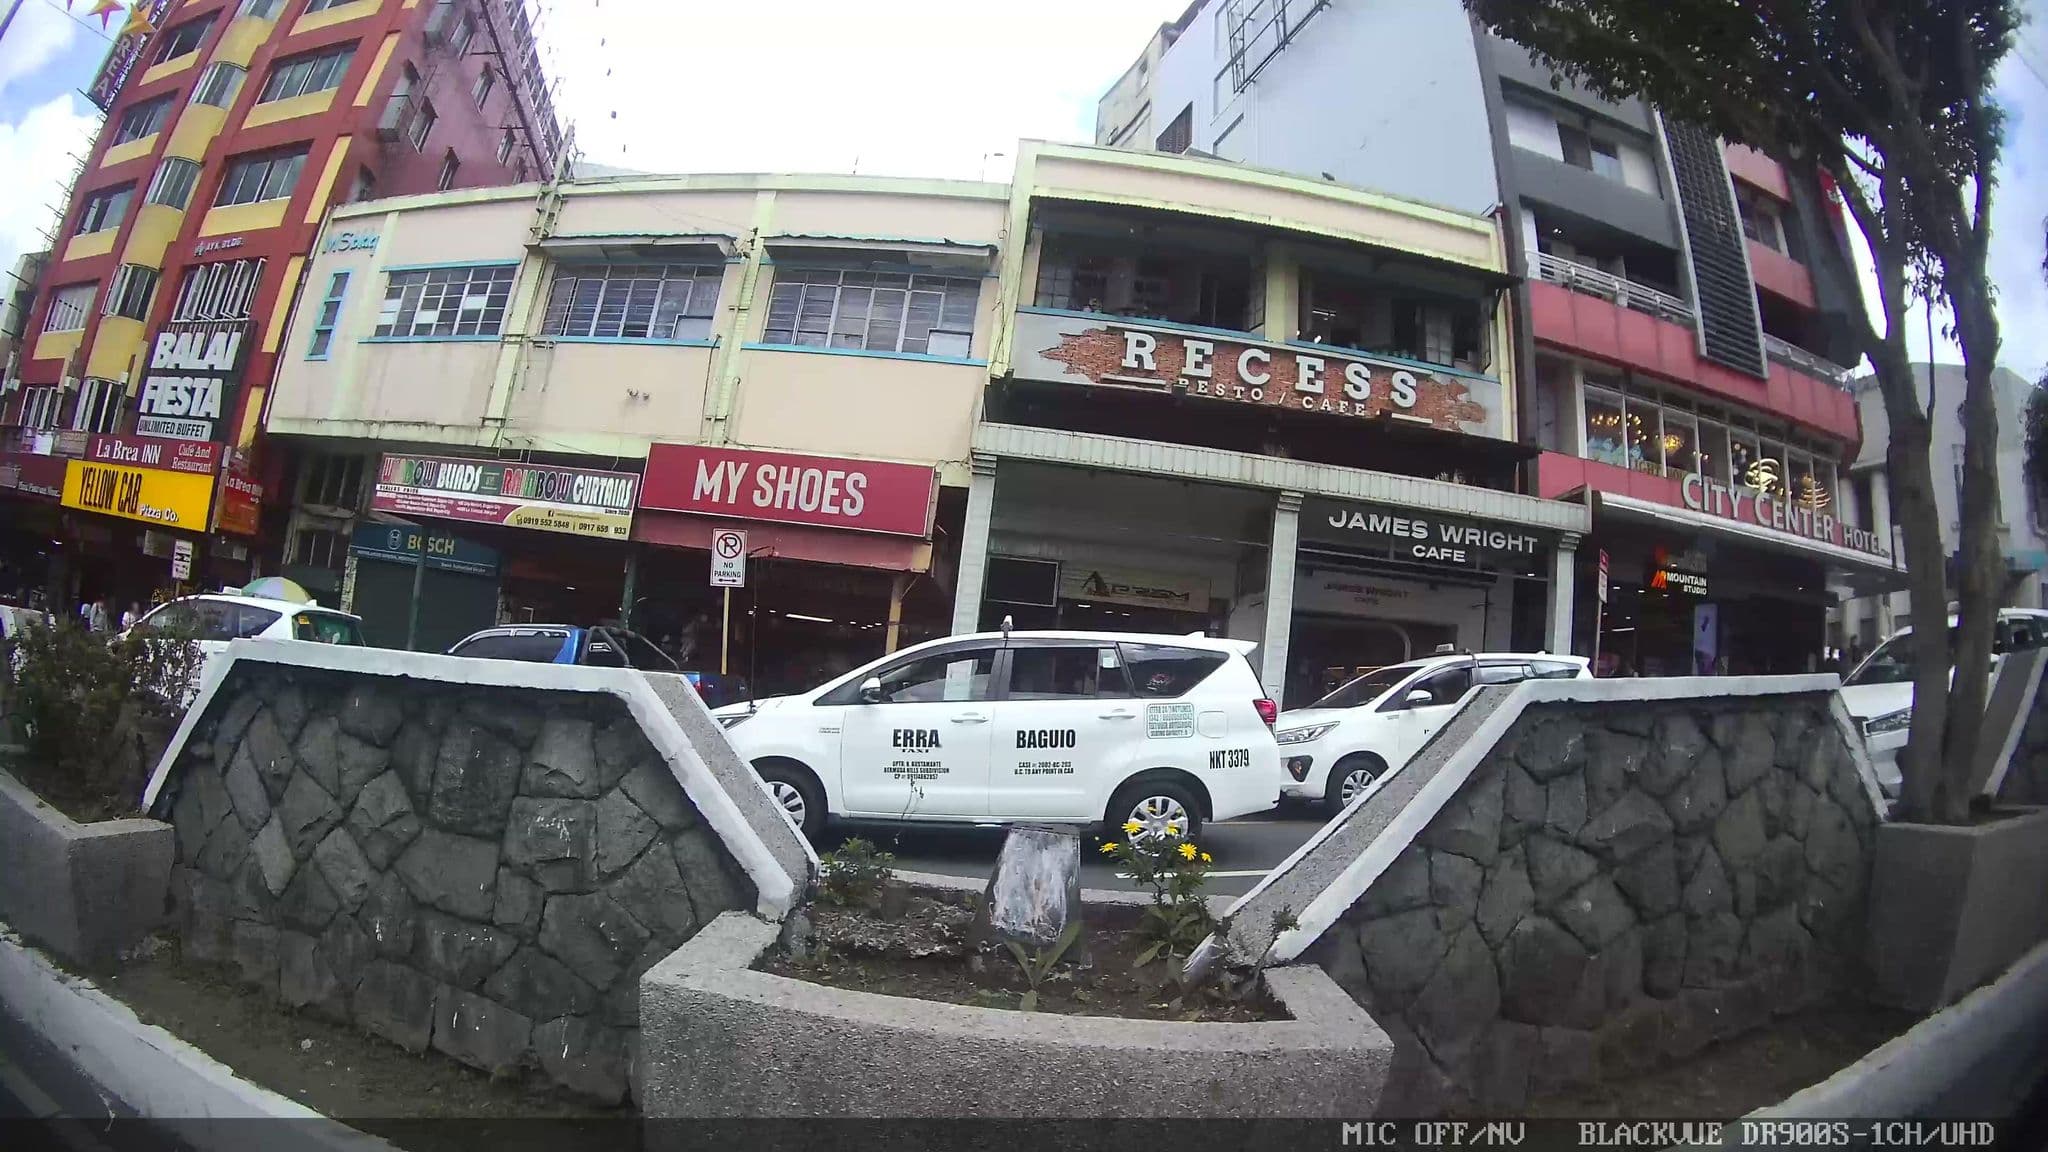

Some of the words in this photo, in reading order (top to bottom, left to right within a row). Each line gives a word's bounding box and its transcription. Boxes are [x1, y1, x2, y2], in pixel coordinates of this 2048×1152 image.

[150, 332, 242, 371] BALAI
[1121, 330, 1417, 408] RECESS
[139, 376, 223, 419] FIESTA
[1302, 396, 1366, 416] CAFE
[139, 420, 175, 434] UNLIMITED
[176, 423, 206, 438] BUFFET
[96, 438, 111, 458] La
[112, 439, 139, 461] Brea
[141, 444, 162, 464] INN
[195, 446, 211, 458] And
[172, 456, 212, 473] Restaurant
[79, 466, 118, 510] YELLOW
[117, 473, 142, 514] CAB
[500, 467, 572, 502] RAINBOW
[692, 459, 749, 504] MY
[752, 464, 868, 516] SHOES
[140, 505, 162, 521] Pizza
[164, 507, 179, 522] Co.
[1682, 472, 1743, 517] CITY
[1754, 492, 1834, 542] CENTER
[1328, 510, 1429, 540] JAMES
[1439, 523, 1538, 554] WRIGHT
[1412, 544, 1466, 563] CAFE
[714, 570, 741, 578] PARKING
[1667, 572, 1707, 587] MOUNTAIN
[1683, 585, 1707, 595] STUDIO
[892, 729, 940, 748] ERRA
[1016, 729, 1076, 749] BAGUIO
[1228, 749, 1249, 768] 3379
